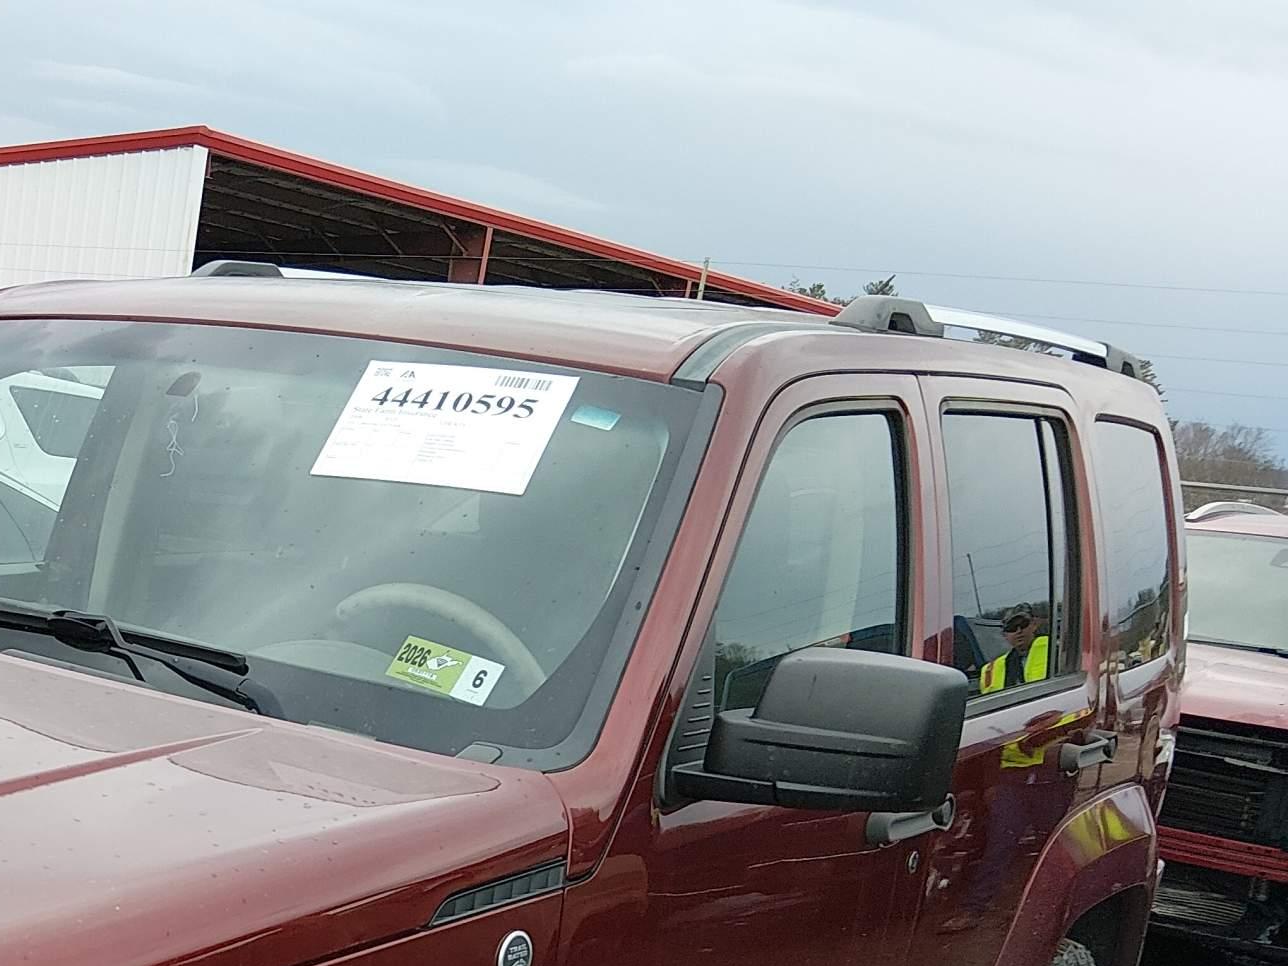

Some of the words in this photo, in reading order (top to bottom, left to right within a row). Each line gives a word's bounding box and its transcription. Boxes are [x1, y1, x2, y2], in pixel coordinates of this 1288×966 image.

[371, 386, 540, 419] 44410595
[397, 643, 432, 668] 2026
[471, 669, 488, 689] 6
